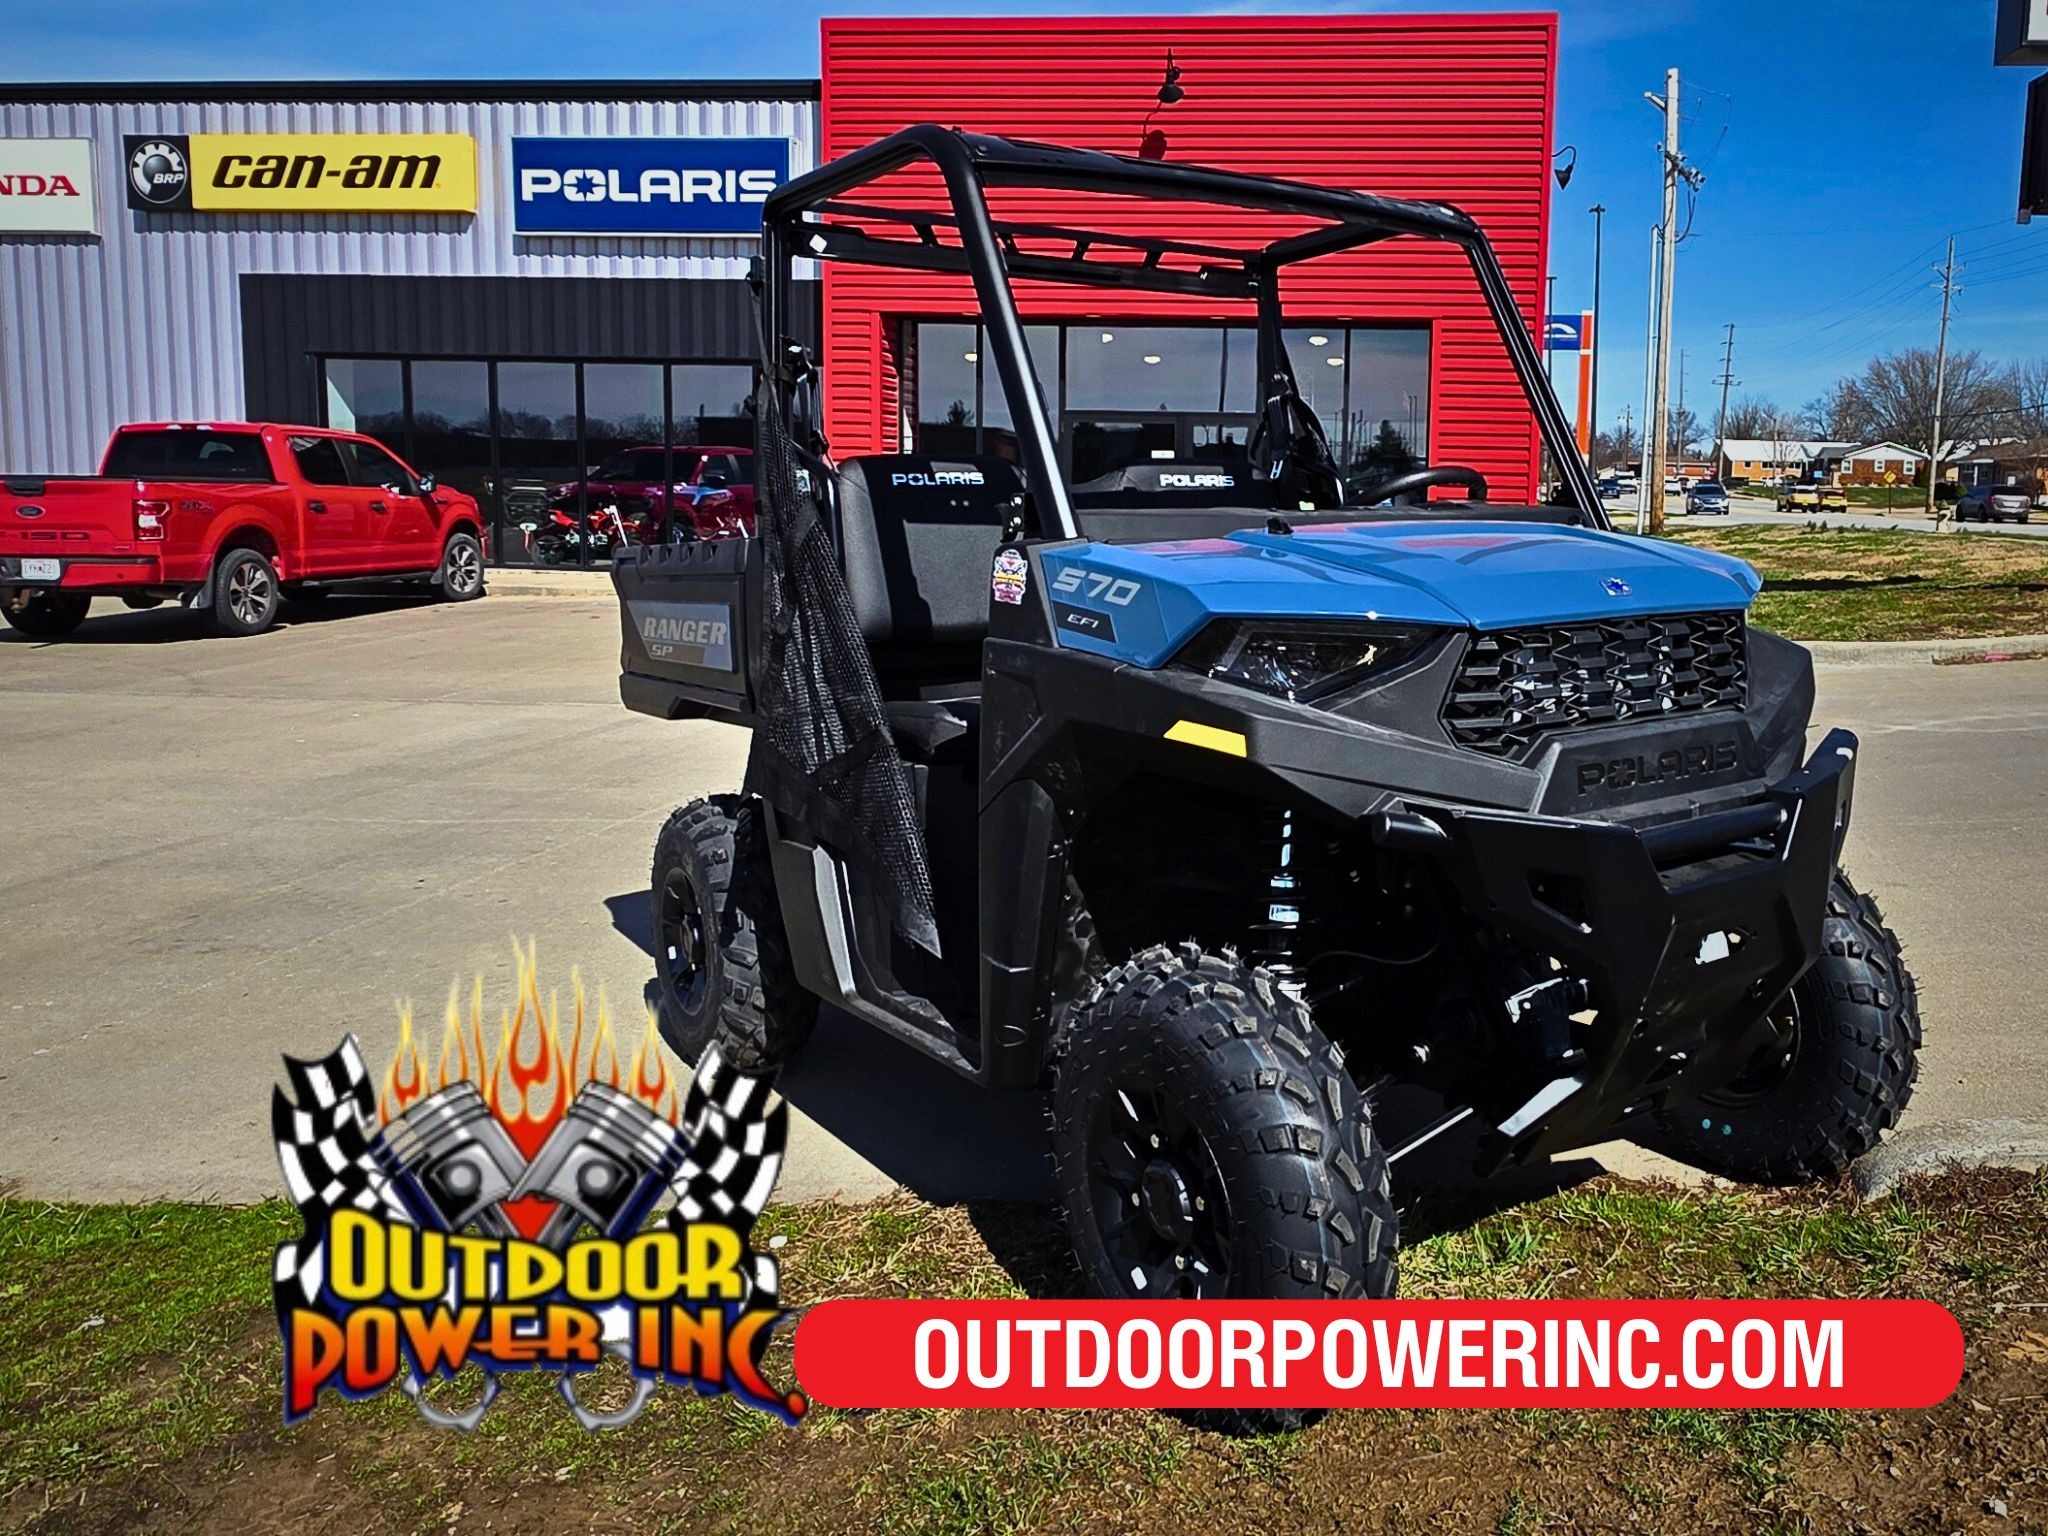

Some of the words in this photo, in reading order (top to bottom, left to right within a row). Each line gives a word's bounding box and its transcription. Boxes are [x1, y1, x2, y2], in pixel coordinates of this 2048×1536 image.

[153, 173, 185, 184] BRP
[211, 155, 441, 189] can-am
[521, 169, 777, 203] POLARIS
[892, 472, 985, 486] POLARIS
[1158, 473, 1235, 488] POLARIS
[1052, 567, 1141, 606] 570
[643, 617, 728, 646] RANGER
[1067, 614, 1099, 628] EFI
[650, 644, 673, 657] SP
[1577, 740, 1738, 797] POLARIS
